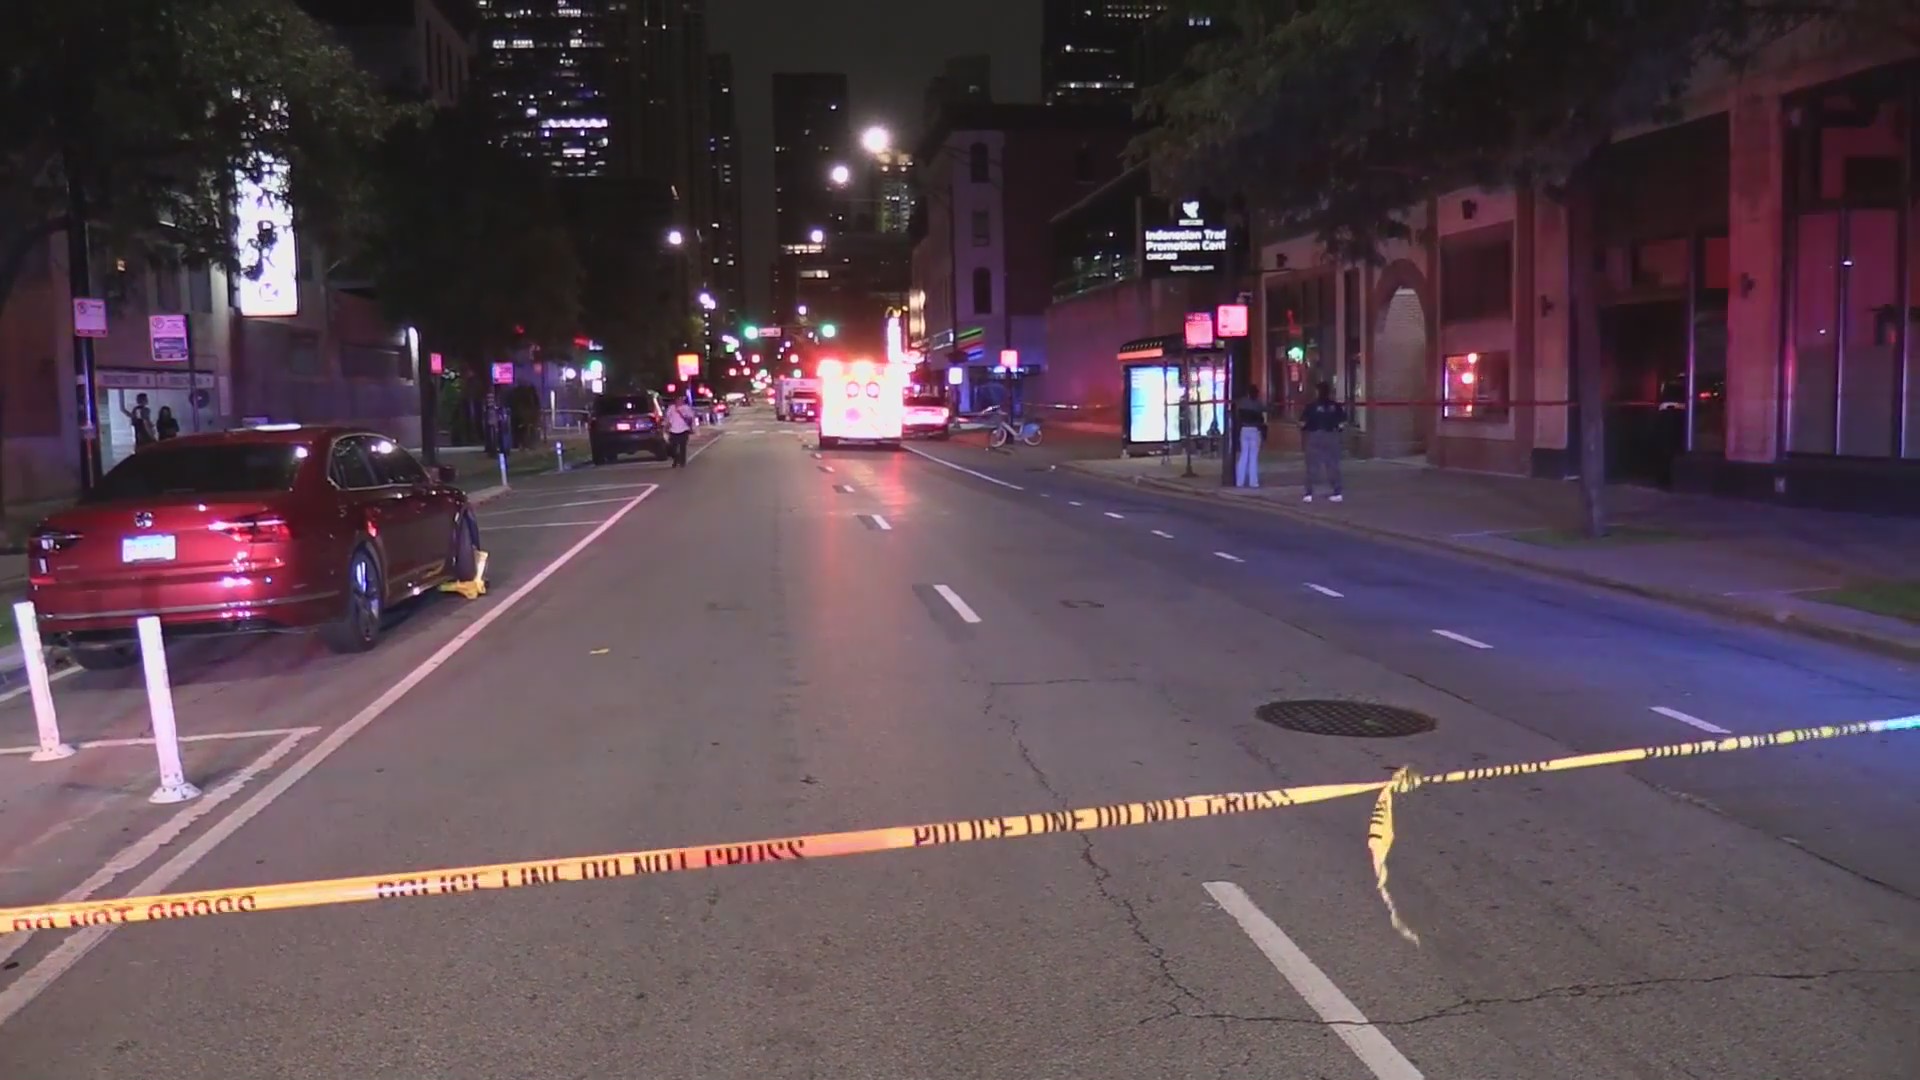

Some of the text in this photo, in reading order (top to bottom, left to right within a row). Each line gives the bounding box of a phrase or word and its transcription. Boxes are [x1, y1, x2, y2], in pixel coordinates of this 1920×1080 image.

[1145, 230, 1202, 241] Indonesian
[1145, 241, 1201, 252] Promotion
[1146, 253, 1178, 261] CHICAGO
